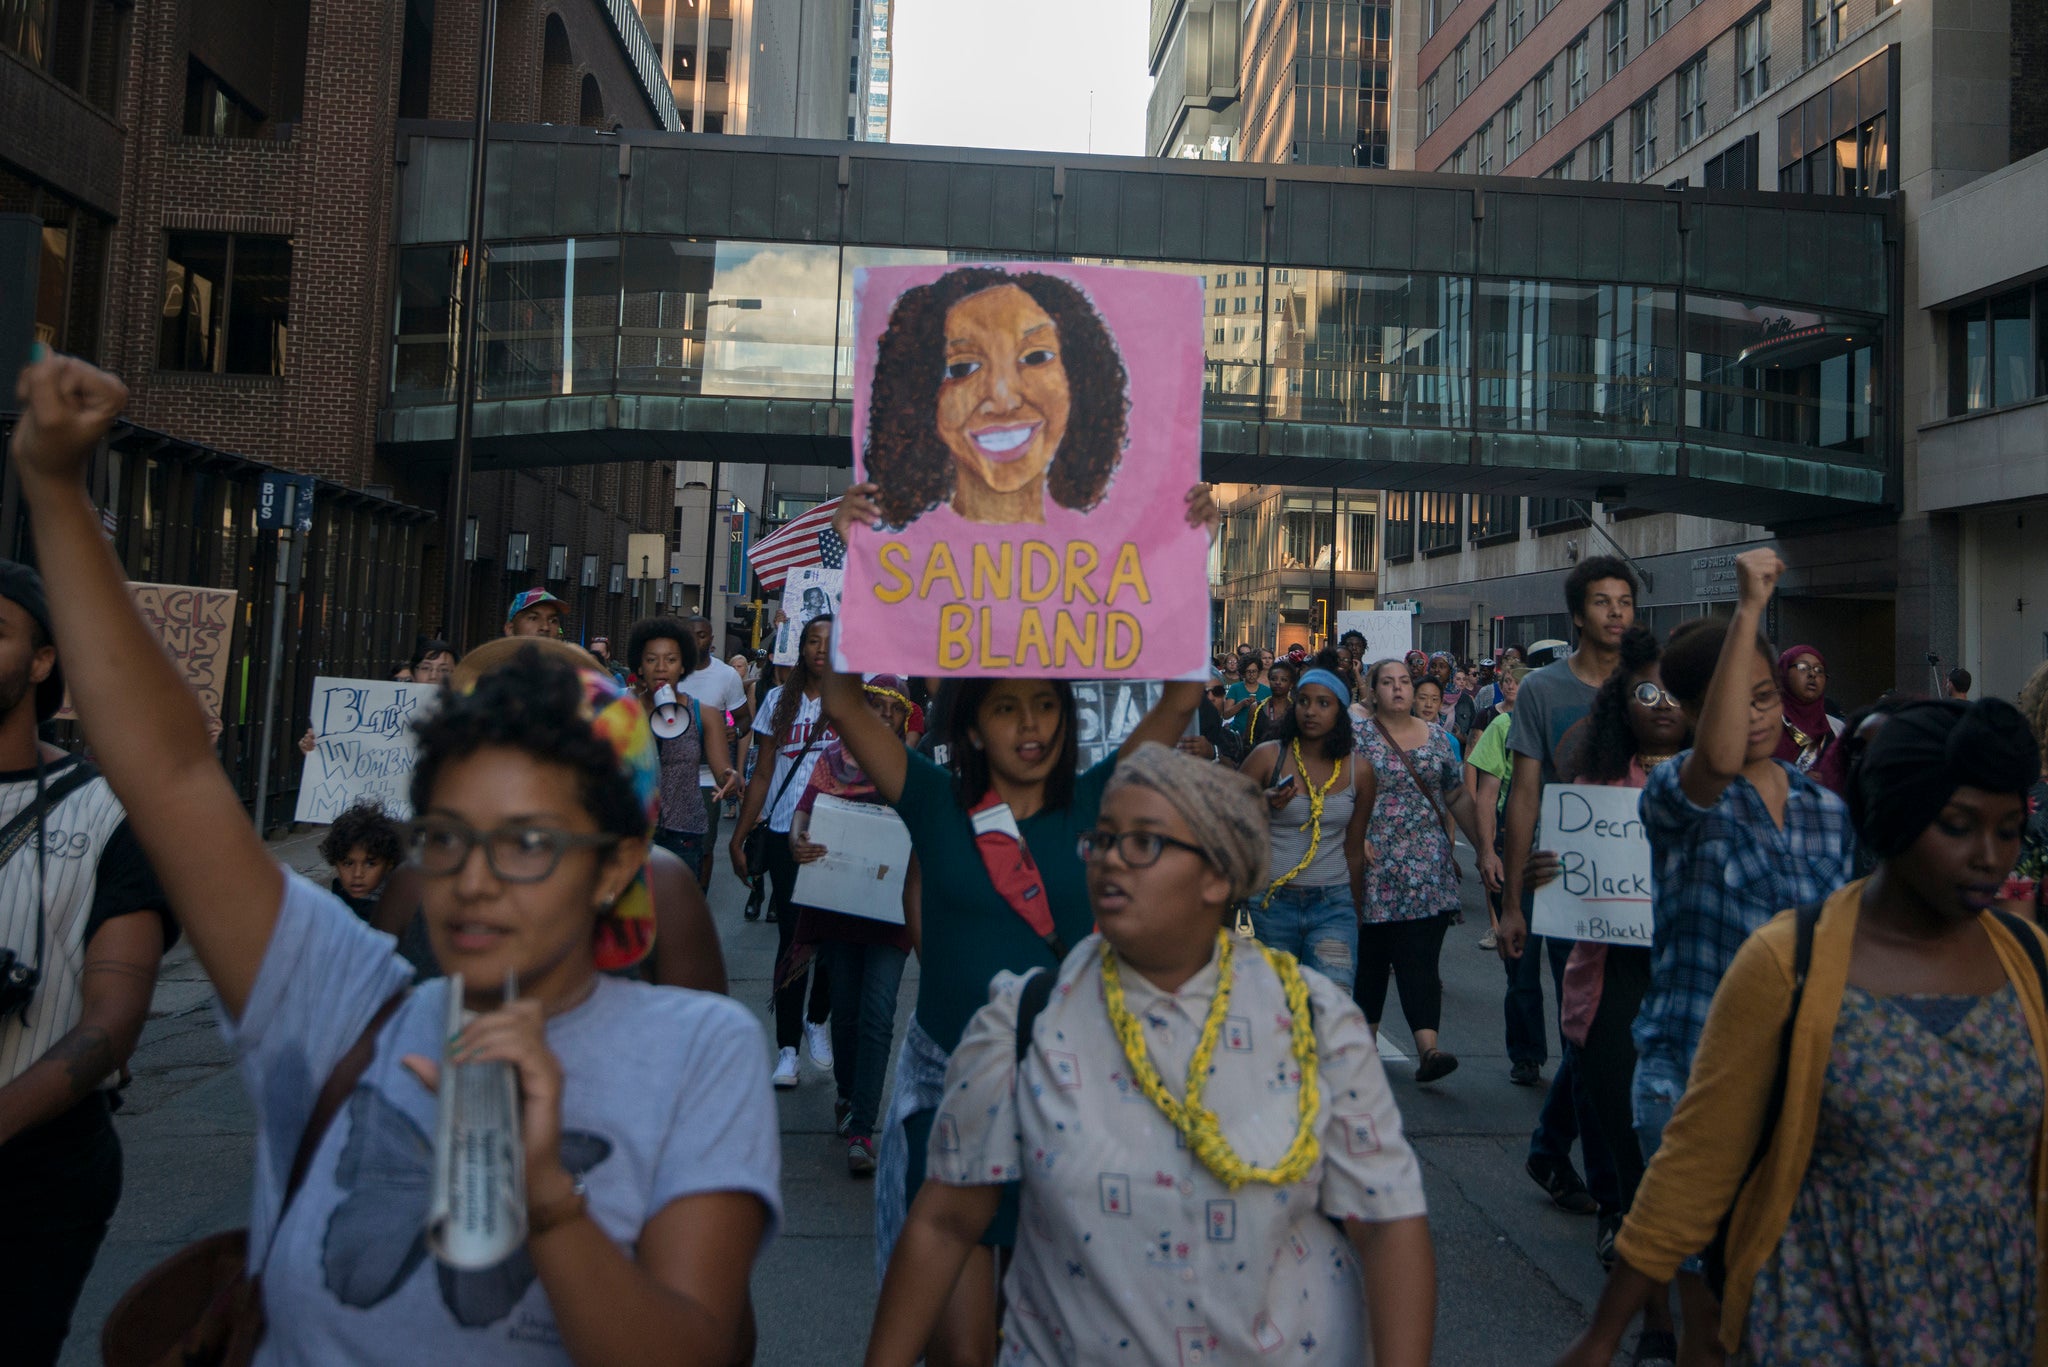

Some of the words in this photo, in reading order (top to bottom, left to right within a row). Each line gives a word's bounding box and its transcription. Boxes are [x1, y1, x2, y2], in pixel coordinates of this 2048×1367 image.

[261, 482, 274, 519] BUS
[873, 540, 1151, 605] SANDRA
[937, 603, 1144, 671] BLAND
[1562, 851, 1651, 897] Black
[1575, 917, 1652, 941] #BlackL
